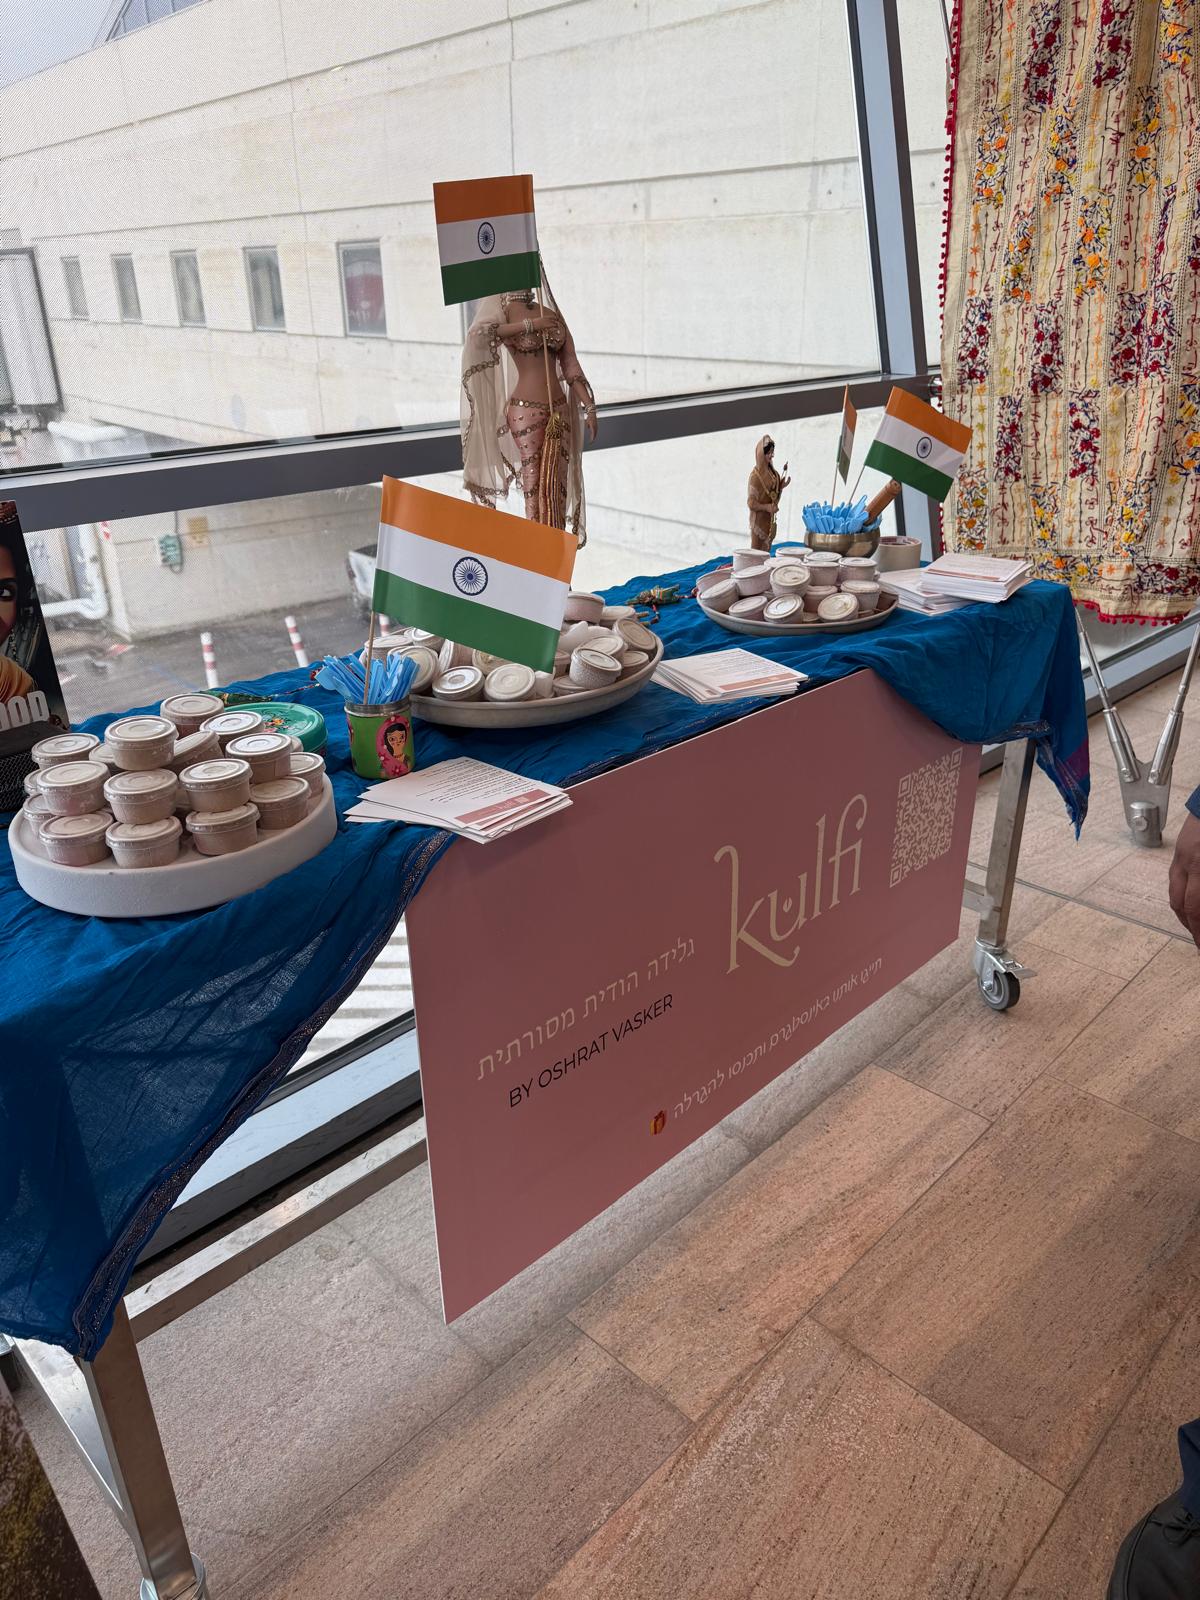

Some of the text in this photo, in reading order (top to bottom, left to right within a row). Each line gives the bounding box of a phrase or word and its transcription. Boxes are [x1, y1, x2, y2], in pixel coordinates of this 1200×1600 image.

[713, 793, 868, 975] kulfi
[477, 936, 695, 1081] גלידה הודית מסורתית
[509, 993, 673, 1108] BY OSHRAT VASKER
[673, 957, 882, 1119] תייגו אותנו באינסטגרם ותכנסו להגרלה
